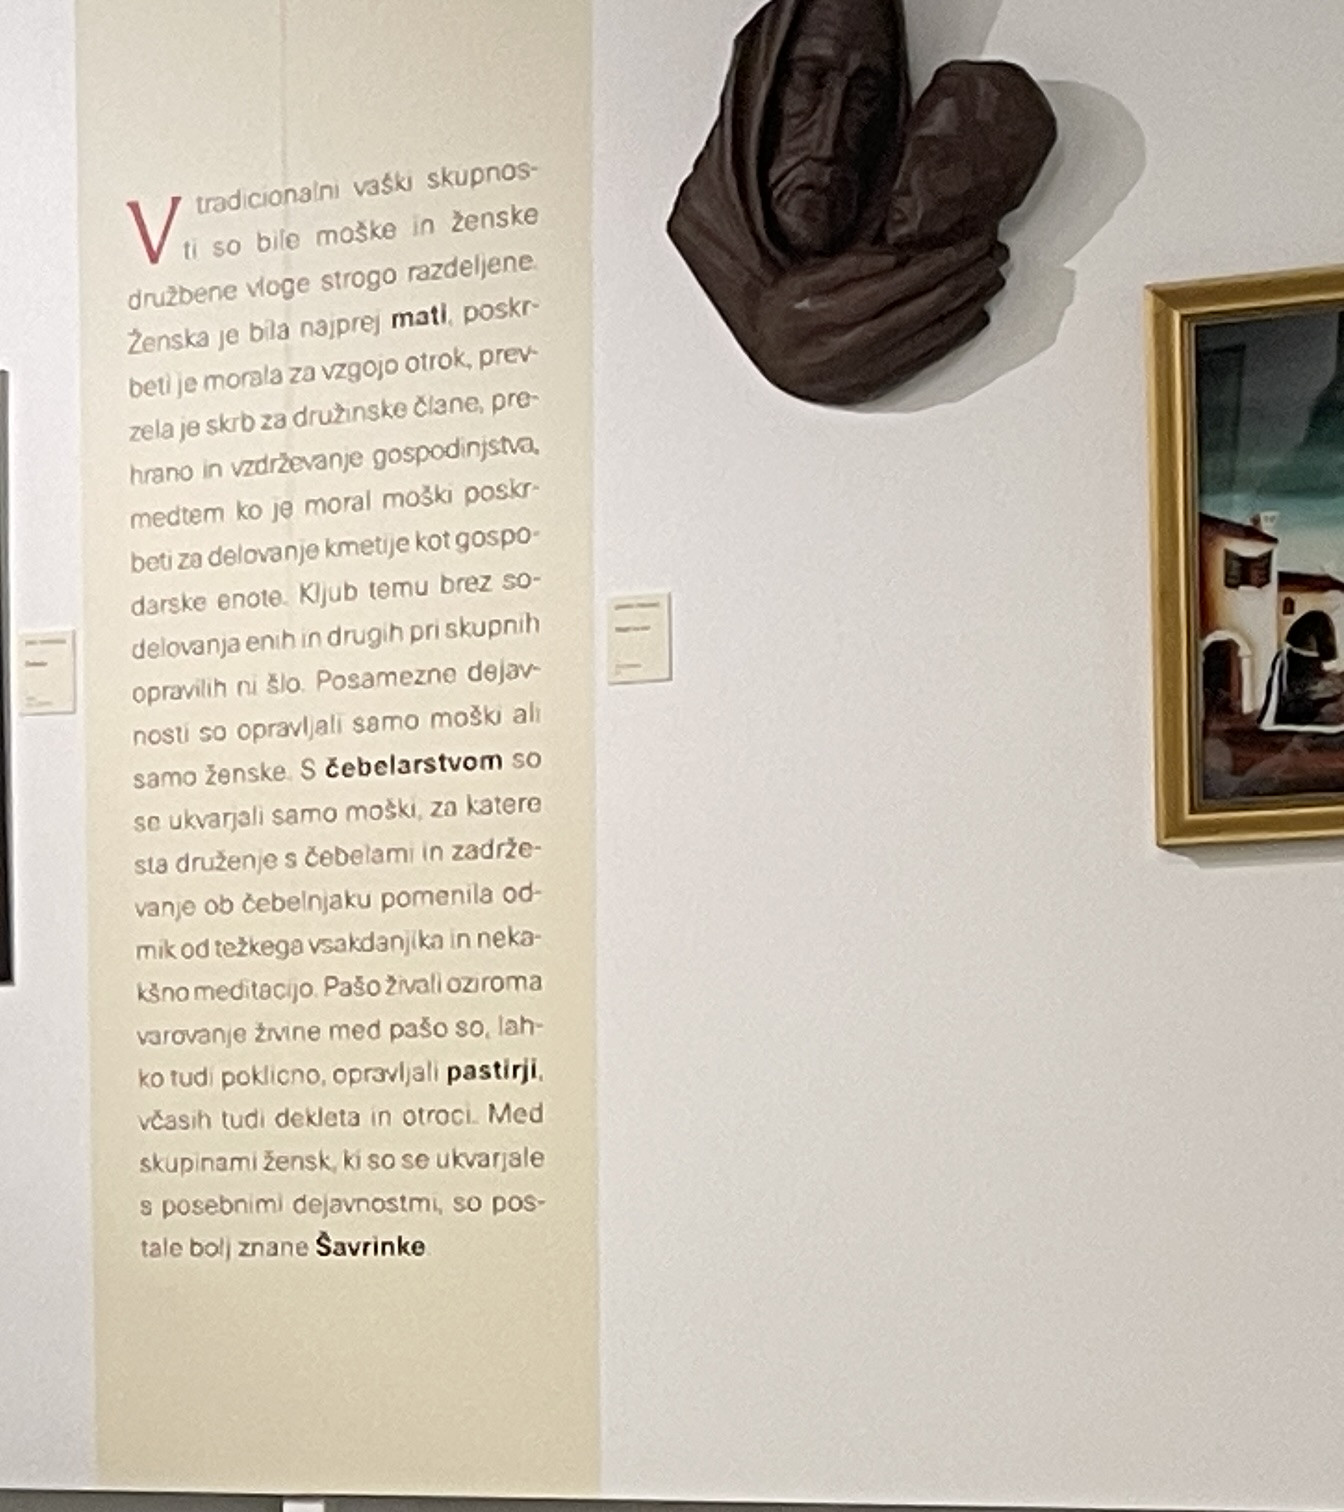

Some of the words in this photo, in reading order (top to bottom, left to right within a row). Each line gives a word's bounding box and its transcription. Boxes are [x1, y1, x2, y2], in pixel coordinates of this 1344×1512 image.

[126, 196, 182, 264] V
[196, 180, 339, 215] tradicionalni
[353, 170, 412, 197] vaški
[427, 161, 538, 189] skupnos-
[184, 241, 196, 260] ti
[213, 238, 241, 257] so
[257, 228, 300, 253] bile
[316, 220, 397, 246] moške
[413, 215, 434, 236] in
[451, 205, 538, 232] ženske
[128, 282, 237, 310] družbene
[246, 275, 310, 300] vloge
[321, 266, 397, 291] strogo
[127, 326, 209, 354] Ženska
[218, 325, 239, 351] je
[250, 320, 289, 343] bila
[300, 315, 381, 340] najprej
[464, 297, 539, 325] poskr-
[129, 373, 171, 397] beti
[177, 371, 197, 399] je
[204, 364, 282, 391] morala
[289, 365, 315, 384] za
[321, 357, 399, 383] vzgojo
[405, 347, 473, 373] otrok,
[479, 347, 538, 371] prev-
[129, 418, 174, 442] zela
[179, 418, 200, 442] je
[206, 410, 255, 435] skrb
[261, 413, 286, 431] za
[293, 399, 407, 427] družinske
[492, 390, 539, 414] pre-
[130, 462, 193, 486] hrano
[203, 460, 222, 479] in
[231, 445, 363, 477] vzdrževanje
[131, 503, 225, 529] medtem
[236, 499, 263, 521] ko
[272, 499, 293, 523] je
[305, 490, 371, 515] moral
[383, 485, 452, 509] moški
[464, 478, 539, 506] poskr-
[131, 551, 172, 573] beti
[177, 552, 202, 569] za
[208, 540, 319, 567] delovanje
[325, 531, 410, 559] kmetije
[415, 529, 450, 551] kot
[455, 526, 540, 553] gospo-
[131, 592, 206, 617] darske
[299, 582, 358, 607] Kljub
[369, 577, 428, 599] temu
[440, 572, 492, 594] brez
[502, 572, 541, 590] so-
[132, 633, 240, 659] delovanja
[246, 629, 295, 651] enih
[301, 629, 321, 647] in
[327, 620, 402, 648] drugih
[410, 620, 439, 644] pri
[445, 612, 540, 638] skupnih
[132, 677, 226, 706] opravilih
[237, 677, 257, 696] ni
[316, 664, 456, 691] Posamezne
[467, 658, 541, 683] dejav-
[133, 721, 189, 746] nosti
[199, 725, 226, 741] so
[237, 710, 342, 743] opravljali
[352, 713, 419, 734] samo
[430, 704, 501, 728] moški
[513, 701, 540, 725] ali
[133, 769, 196, 790] samo
[300, 758, 316, 780] S
[325, 752, 503, 779] čebelarstvom
[512, 751, 541, 769] so
[134, 814, 160, 832] se
[169, 805, 263, 833] ukvarjali
[272, 803, 338, 825] samo
[430, 800, 456, 818] za
[467, 793, 541, 816] katere
[134, 854, 168, 875] sta
[175, 847, 278, 875] druženje
[285, 851, 297, 868] s
[305, 842, 414, 867] čebelami
[422, 842, 443, 861] in
[451, 837, 541, 861] zadrže-
[135, 898, 195, 922] vanje
[204, 896, 234, 915] ob
[242, 888, 372, 916] čebelnjaku
[381, 881, 493, 910] pomenila
[503, 881, 541, 904] od-
[136, 938, 177, 961] mik
[181, 936, 209, 959] od
[215, 932, 304, 962] težkega
[309, 931, 443, 957] vsakdanjika
[450, 931, 470, 950] in
[477, 926, 541, 948] neka-
[137, 981, 189, 1004] kšno
[324, 974, 381, 998] Pašo
[384, 970, 441, 995] živali
[447, 972, 542, 994] oziroma
[137, 1020, 247, 1049] varovanje
[255, 1021, 321, 1044] živine
[329, 1018, 380, 1040] med
[390, 1016, 448, 1042] pašo
[455, 1017, 490, 1039] so,
[498, 1013, 543, 1037] lah-
[138, 1068, 164, 1088] ko
[170, 1066, 213, 1088] tudi
[221, 1064, 326, 1089] poklicno,
[332, 1059, 438, 1088] opravljali
[446, 1056, 543, 1085] pastirji,
[138, 1106, 210, 1131] včasih
[222, 1108, 264, 1130] tudi
[275, 1104, 360, 1128] dekleta
[372, 1106, 391, 1127] in
[489, 1101, 543, 1124] Med
[139, 1150, 257, 1176] skupinami
[344, 1148, 361, 1169] ki
[368, 1153, 395, 1170] so
[402, 1151, 429, 1170] se
[436, 1145, 545, 1172] ukvarjale
[141, 1199, 152, 1216] s
[162, 1192, 282, 1220] posebnimi
[293, 1191, 443, 1219] dejavnostmi,
[453, 1193, 482, 1213] so
[492, 1192, 545, 1215] pos-
[141, 1237, 182, 1259] tale
[190, 1237, 231, 1262] bolj
[238, 1238, 308, 1258] znane
